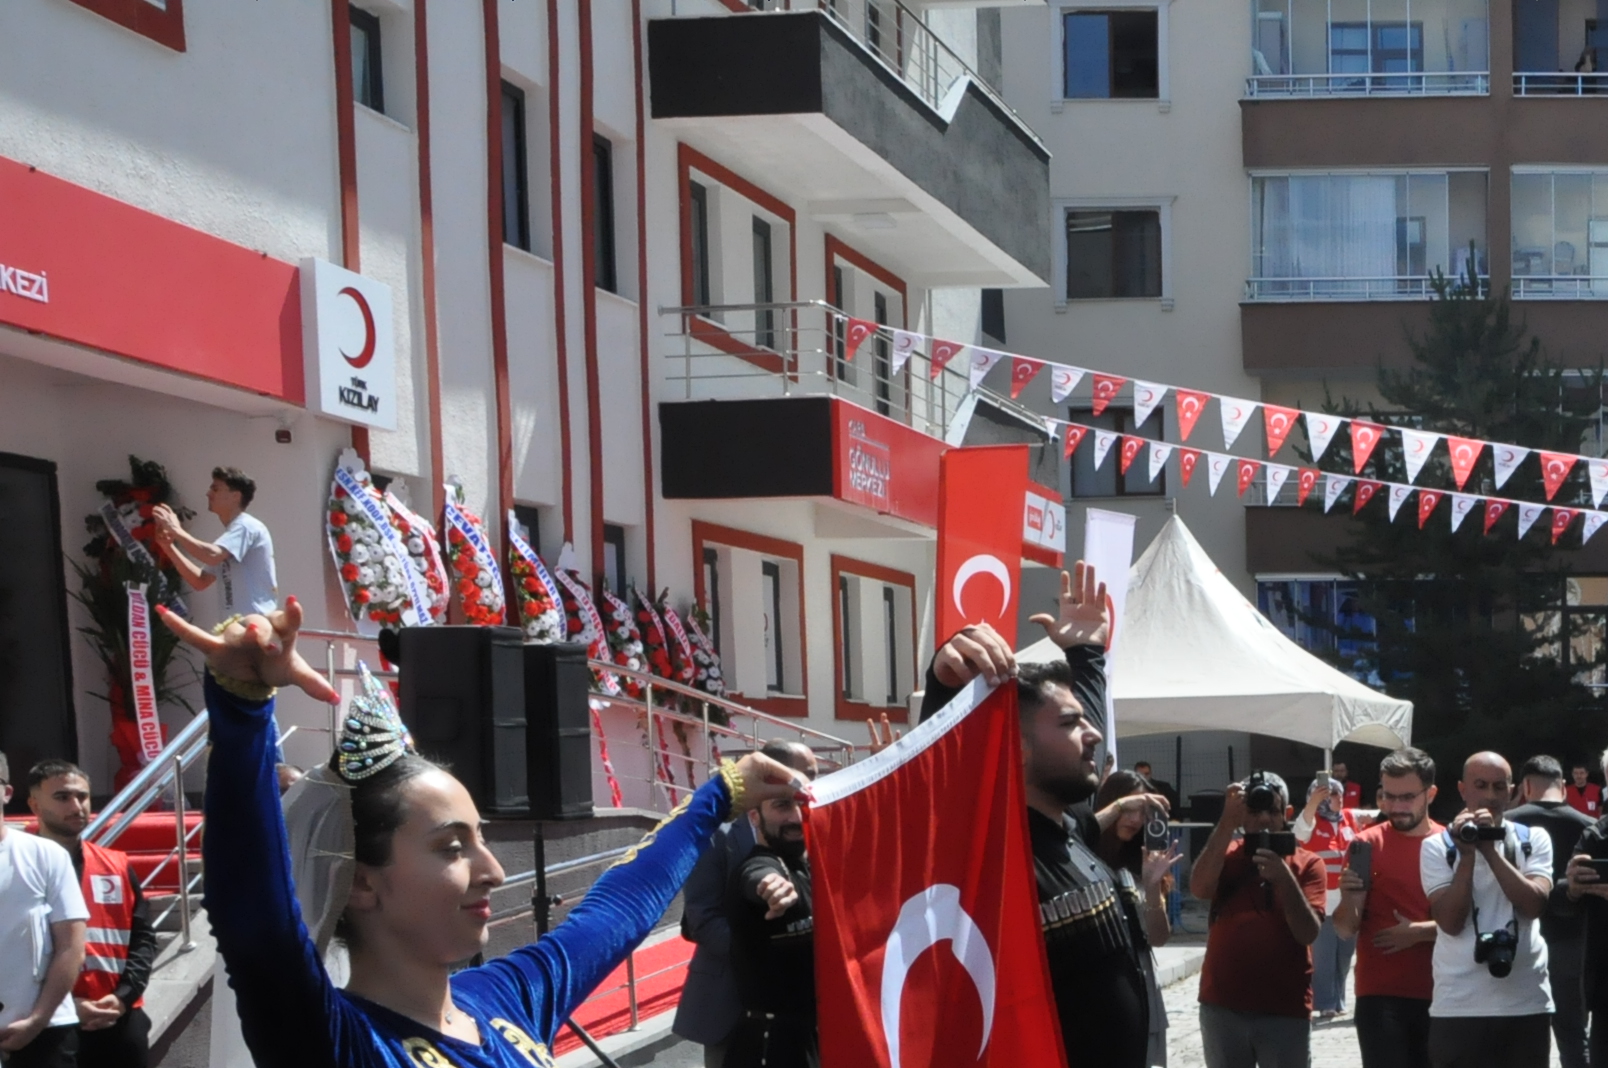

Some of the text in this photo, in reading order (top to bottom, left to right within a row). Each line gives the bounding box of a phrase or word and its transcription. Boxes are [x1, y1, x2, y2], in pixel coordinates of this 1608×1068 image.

[0, 262, 49, 303] KEZİ
[338, 384, 380, 414] KIZILAY
[445, 504, 489, 554] CEVAT
[131, 631, 150, 669] CÜCÜ
[134, 672, 146, 682] &
[136, 685, 154, 720] MİNA
